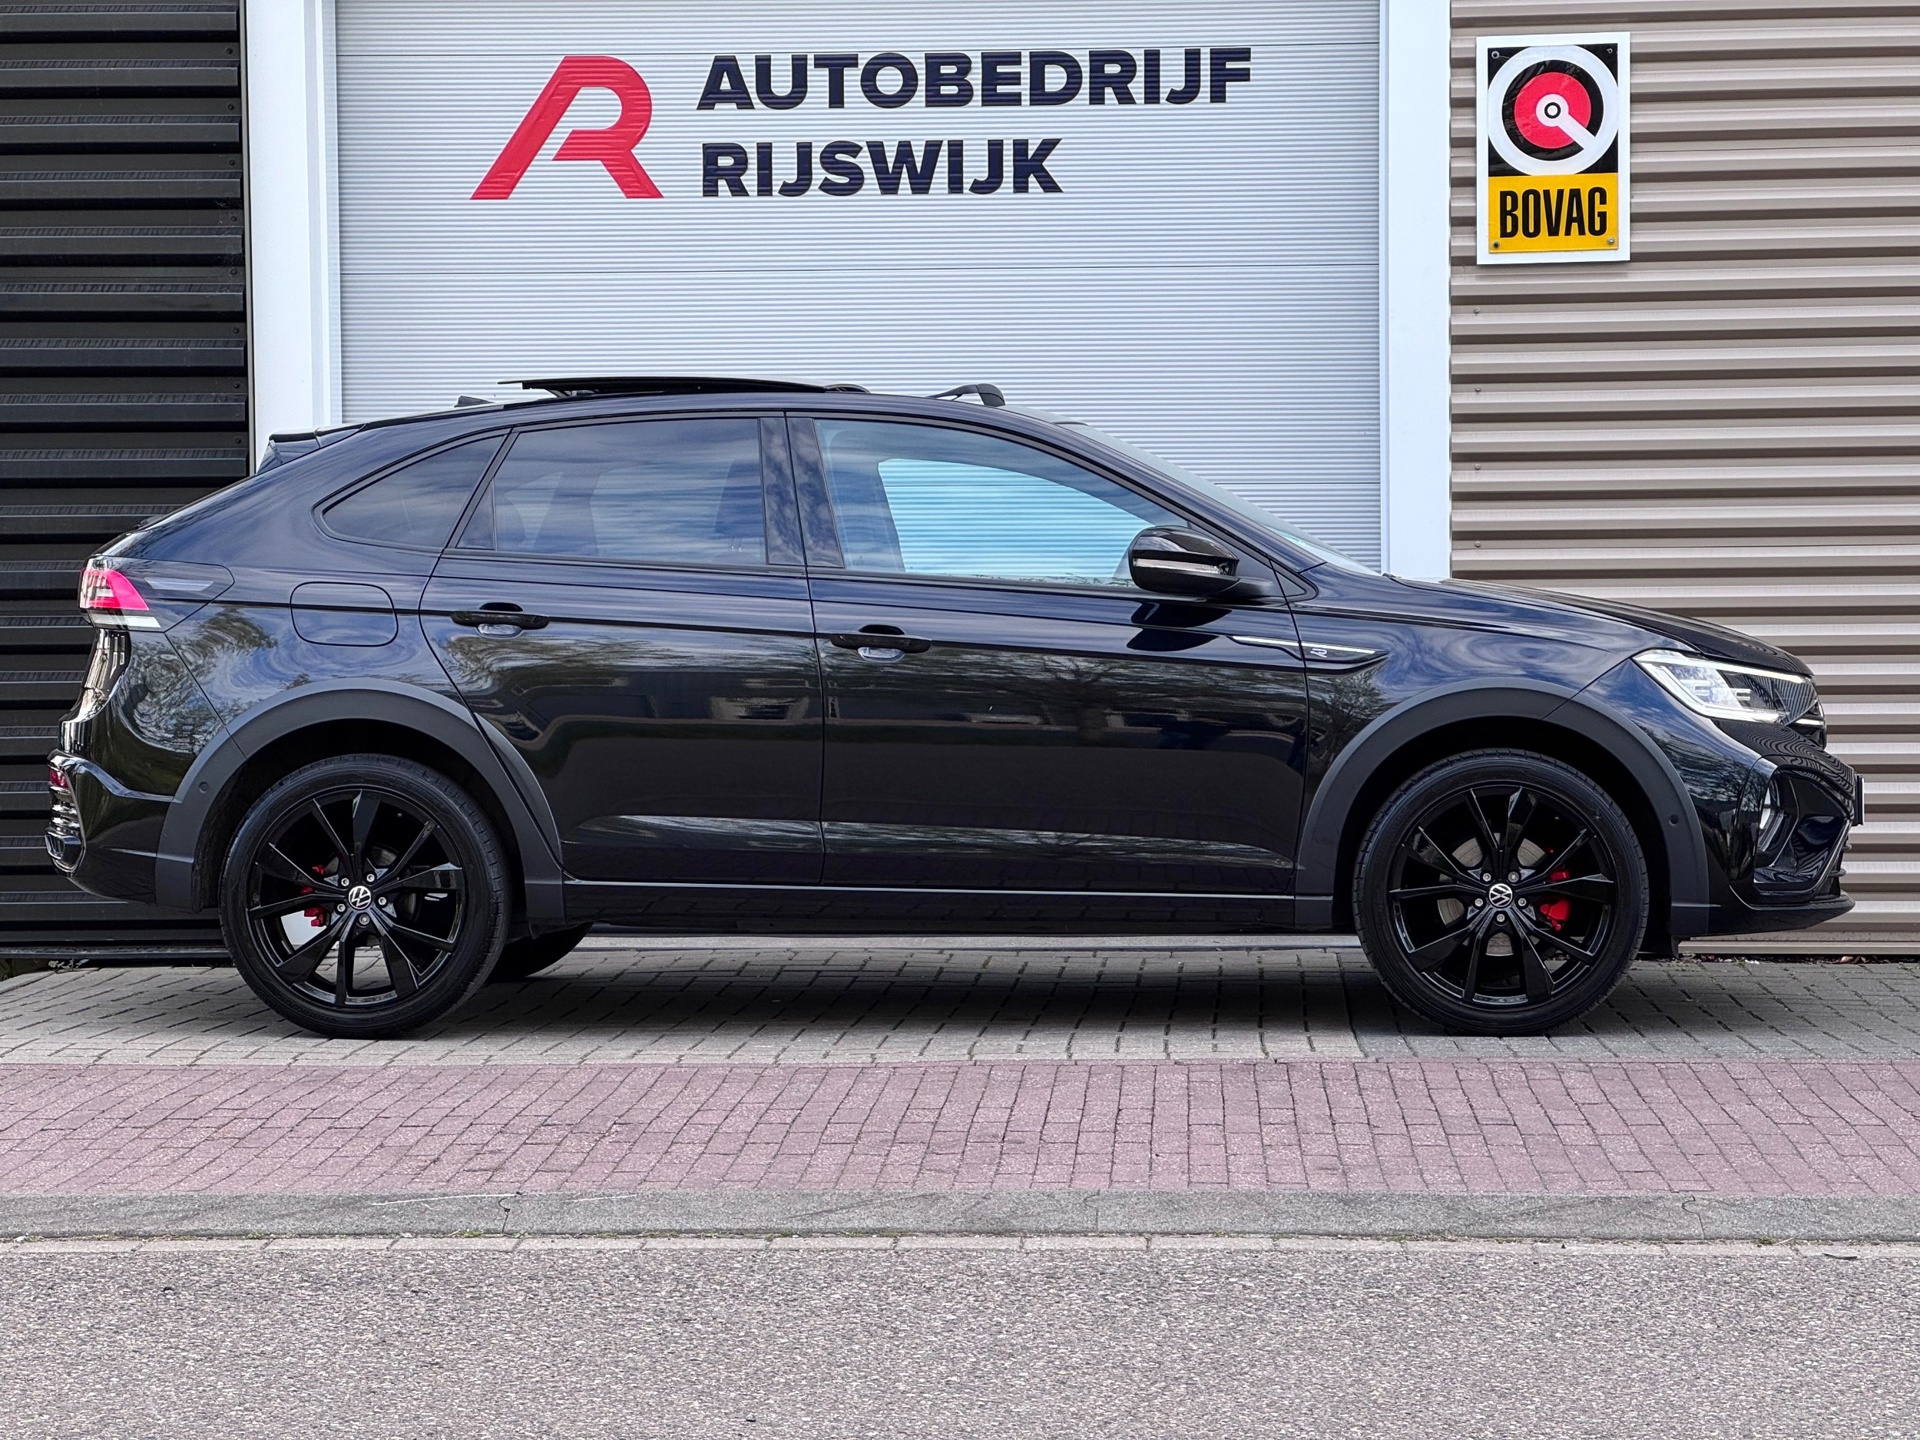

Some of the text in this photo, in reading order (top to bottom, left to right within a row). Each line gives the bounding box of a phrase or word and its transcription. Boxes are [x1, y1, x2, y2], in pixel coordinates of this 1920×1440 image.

[697, 48, 1251, 110] AUTOBEDRIJF
[703, 139, 1063, 198] RIJSWIJK
[1499, 187, 1607, 238] BOVAG
